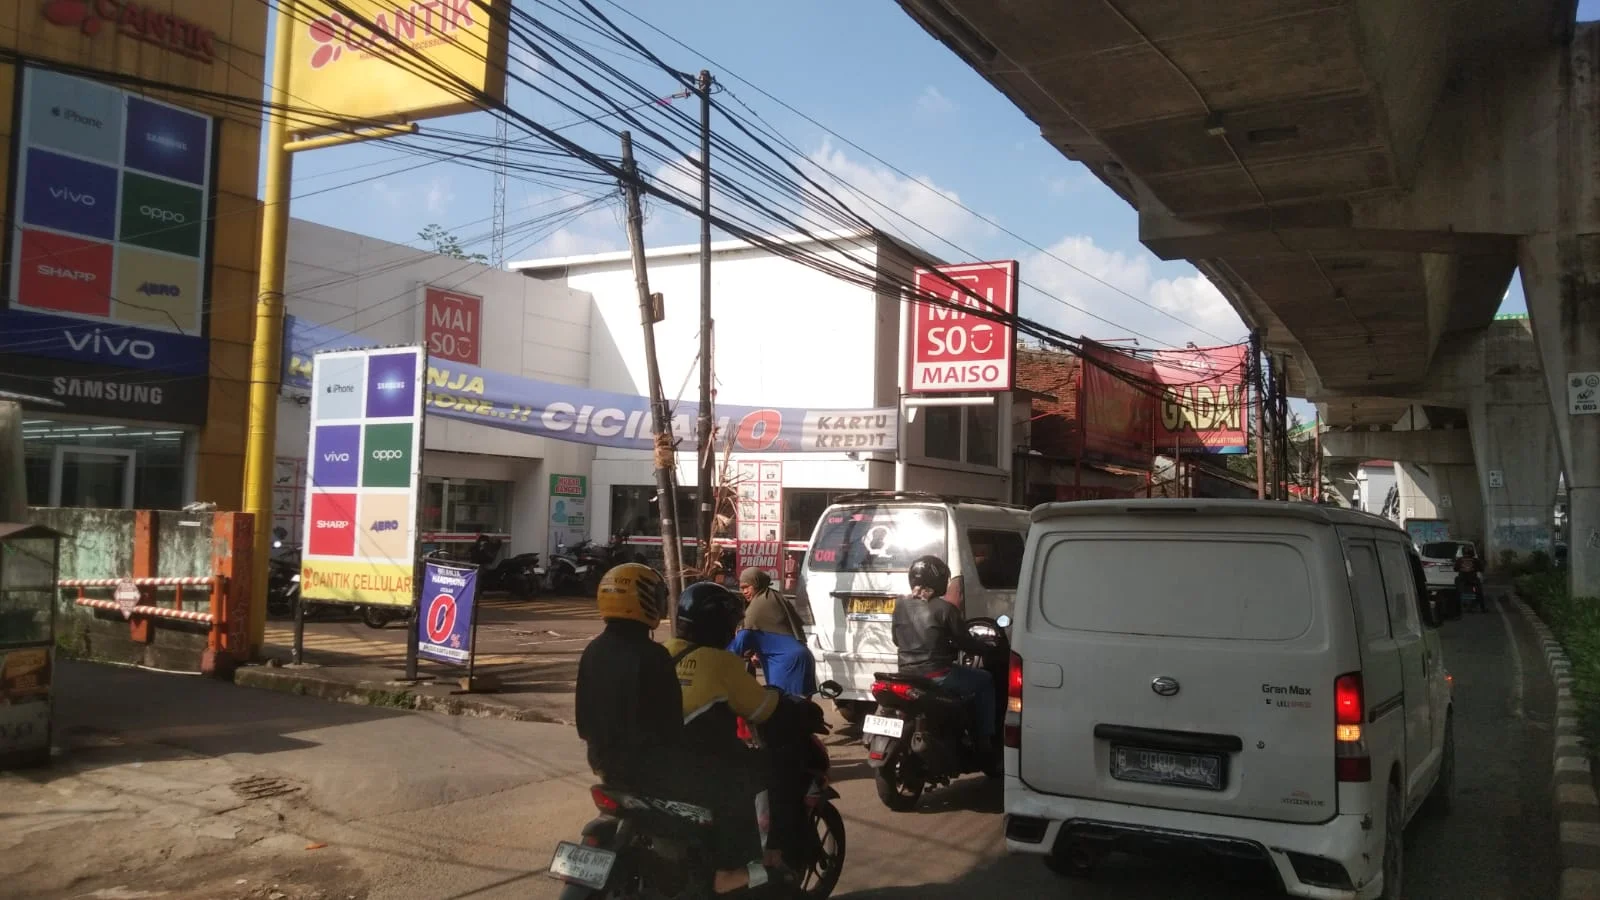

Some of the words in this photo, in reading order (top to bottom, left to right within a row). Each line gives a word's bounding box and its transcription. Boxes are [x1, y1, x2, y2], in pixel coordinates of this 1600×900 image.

[343, 0, 475, 51] CANTIK
[63, 108, 104, 129] iPhone
[49, 186, 96, 206] vivo
[139, 205, 185, 223] oppo
[928, 286, 994, 321] MAI
[431, 303, 472, 333] MAI
[64, 328, 155, 360] vivo
[427, 367, 485, 395] NJA
[921, 364, 1000, 384] MAISO
[53, 376, 163, 405] SAMSUNG
[332, 384, 355, 394] iPhone
[1160, 384, 1243, 432] GADAI
[817, 414, 888, 431] KARTU
[815, 432, 887, 448] KREDIT
[324, 451, 349, 462] vivo
[372, 449, 403, 461] oppo
[316, 520, 349, 529] SHARP
[370, 520, 398, 533] AERO
[739, 542, 779, 556] SELALU
[740, 556, 777, 567] PROMO!
[313, 572, 351, 589] CANTIK
[353, 574, 412, 593] CELLULAR
[1262, 683, 1287, 695] Gran
[1289, 685, 1312, 696] Max
